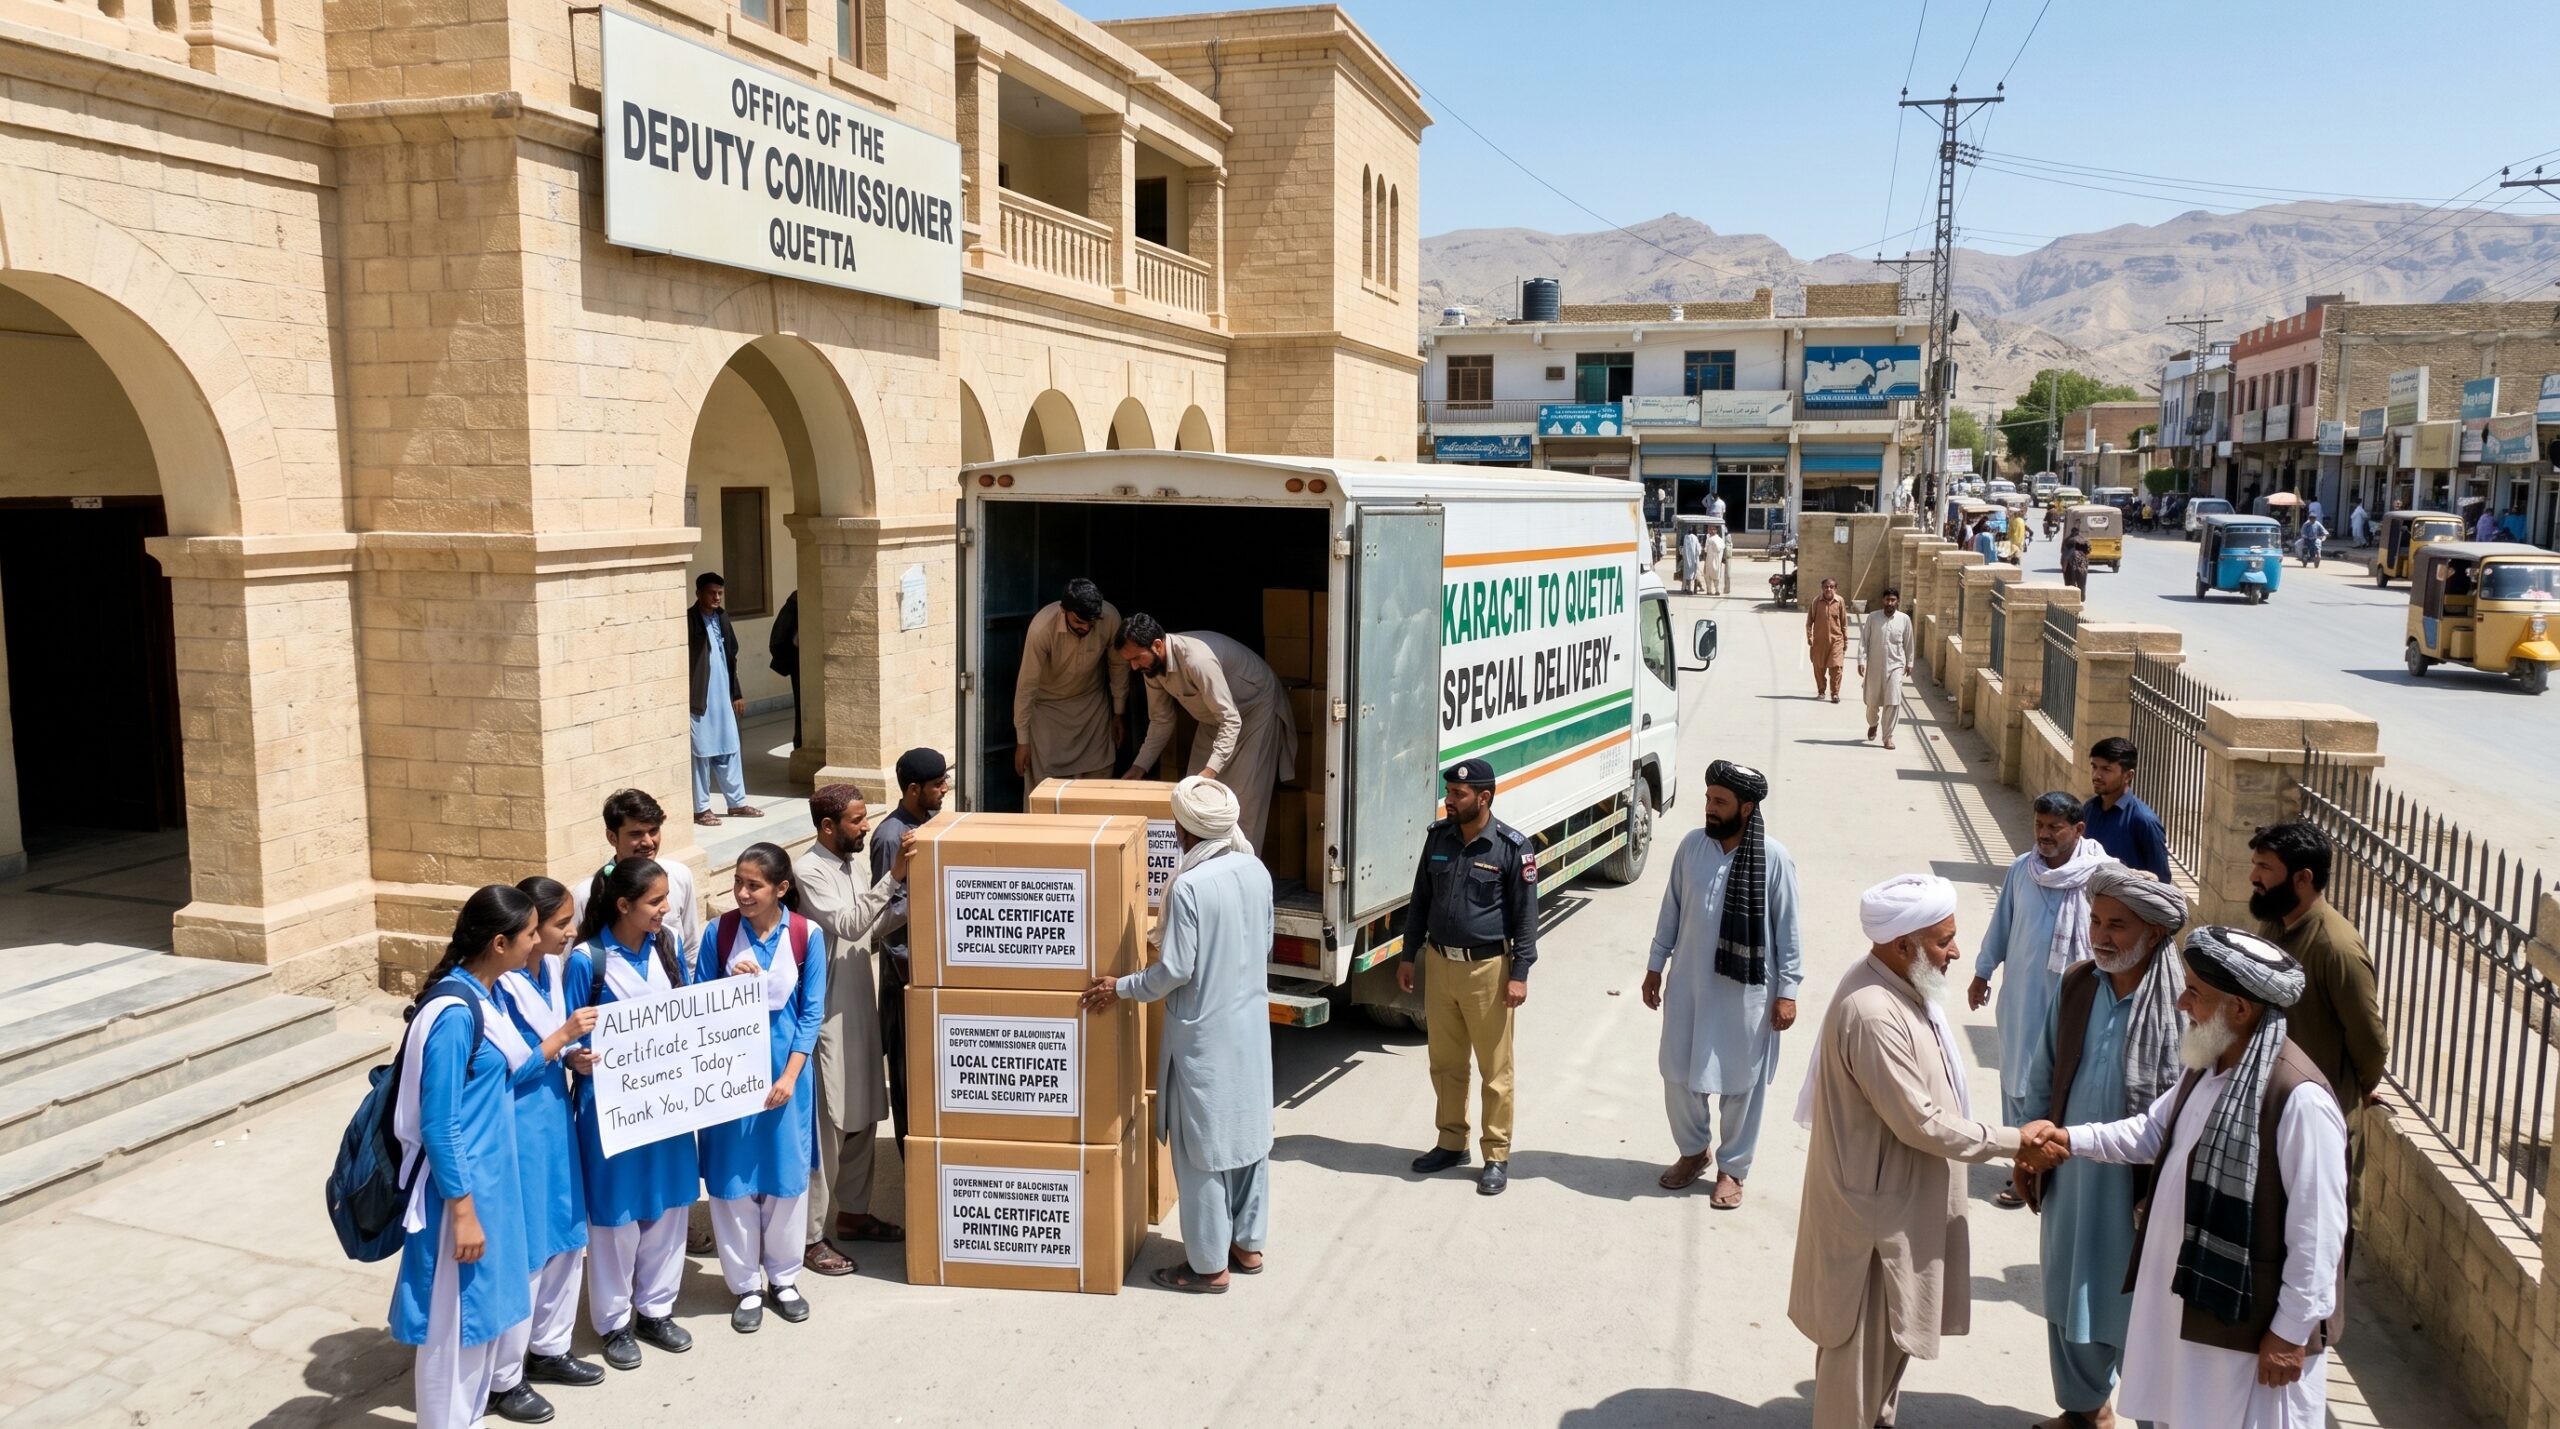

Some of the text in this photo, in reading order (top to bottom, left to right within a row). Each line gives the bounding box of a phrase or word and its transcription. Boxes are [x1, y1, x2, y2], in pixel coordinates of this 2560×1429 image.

[732, 78, 884, 164] OFFICE OF THE
[623, 100, 953, 244] DEPUTY COMMISSIONER
[769, 217, 856, 272] QUETTA
[1442, 566, 1623, 646] KARACHI TO QUETTA
[1443, 655, 1527, 731] SPECIAL
[1534, 635, 1612, 705] DELIVERY
[1009, 881, 1019, 889] OF
[956, 891, 985, 900] DEPUTY
[957, 908, 1074, 922] LOCAL CERTIFICATE
[966, 925, 1065, 939] PRINTING PAPER
[957, 943, 1075, 955] SPECIAL SECURITY PAPER
[603, 982, 760, 1037] ALHAMDULILLAH!
[1002, 1029, 1011, 1038] OF
[604, 1022, 760, 1069] Certificate Issuance
[979, 1040, 1036, 1049] COMMISSIONER
[950, 1054, 1067, 1070] LOCAL CERTIFICATE
[622, 1067, 682, 1092] Resumes
[691, 1053, 733, 1077] Today
[960, 1072, 1059, 1088] PRINTING PAPER
[605, 1075, 764, 1130] Thank You, DC Quetta
[951, 1089, 1068, 1103] SPECIAL SECURITY PAPER
[1005, 1180, 1015, 1189] OF
[1017, 1182, 1068, 1191] BALOCHISTAN
[953, 1205, 1070, 1222] LOCAL CERTIFICATE
[962, 1222, 1061, 1240] PRINTING PAPER
[953, 1239, 1071, 1255] SPECIAL SECURITY PAPER
